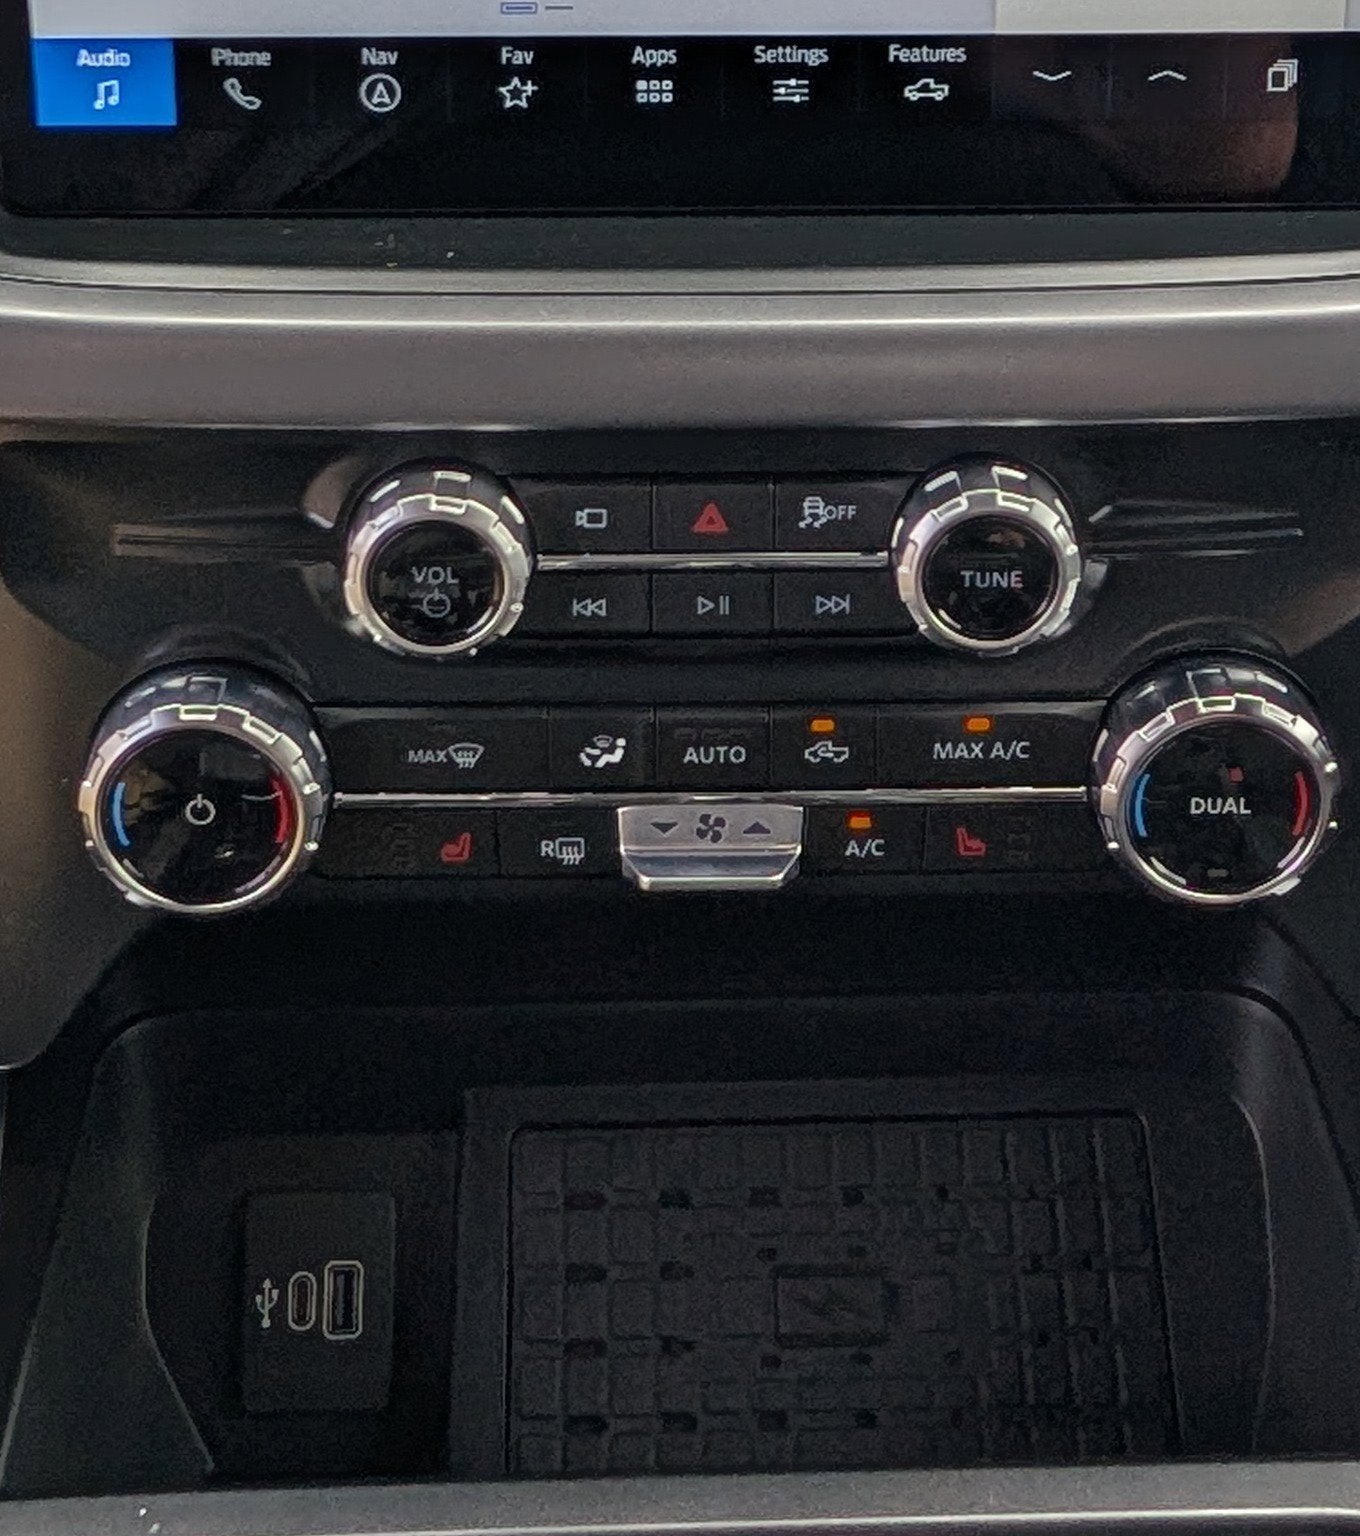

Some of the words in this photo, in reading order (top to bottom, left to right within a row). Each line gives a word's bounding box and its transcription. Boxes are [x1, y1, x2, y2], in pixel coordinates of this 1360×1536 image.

[77, 48, 131, 68] Audio
[211, 47, 272, 67] Phone
[360, 47, 399, 66] Nav
[500, 46, 535, 65] Fav
[631, 45, 677, 67] Apps
[754, 44, 829, 66] Settings
[887, 43, 967, 63] Features
[823, 505, 858, 520] OFF
[410, 566, 459, 585] VOL
[959, 569, 1024, 588] TUNE
[408, 749, 448, 764] MAX
[683, 745, 747, 764] AUTO
[933, 740, 984, 760] MAX
[990, 739, 1031, 761] A/C
[1189, 797, 1252, 816] DUAL
[540, 840, 554, 858] R
[844, 838, 886, 859] A/C
